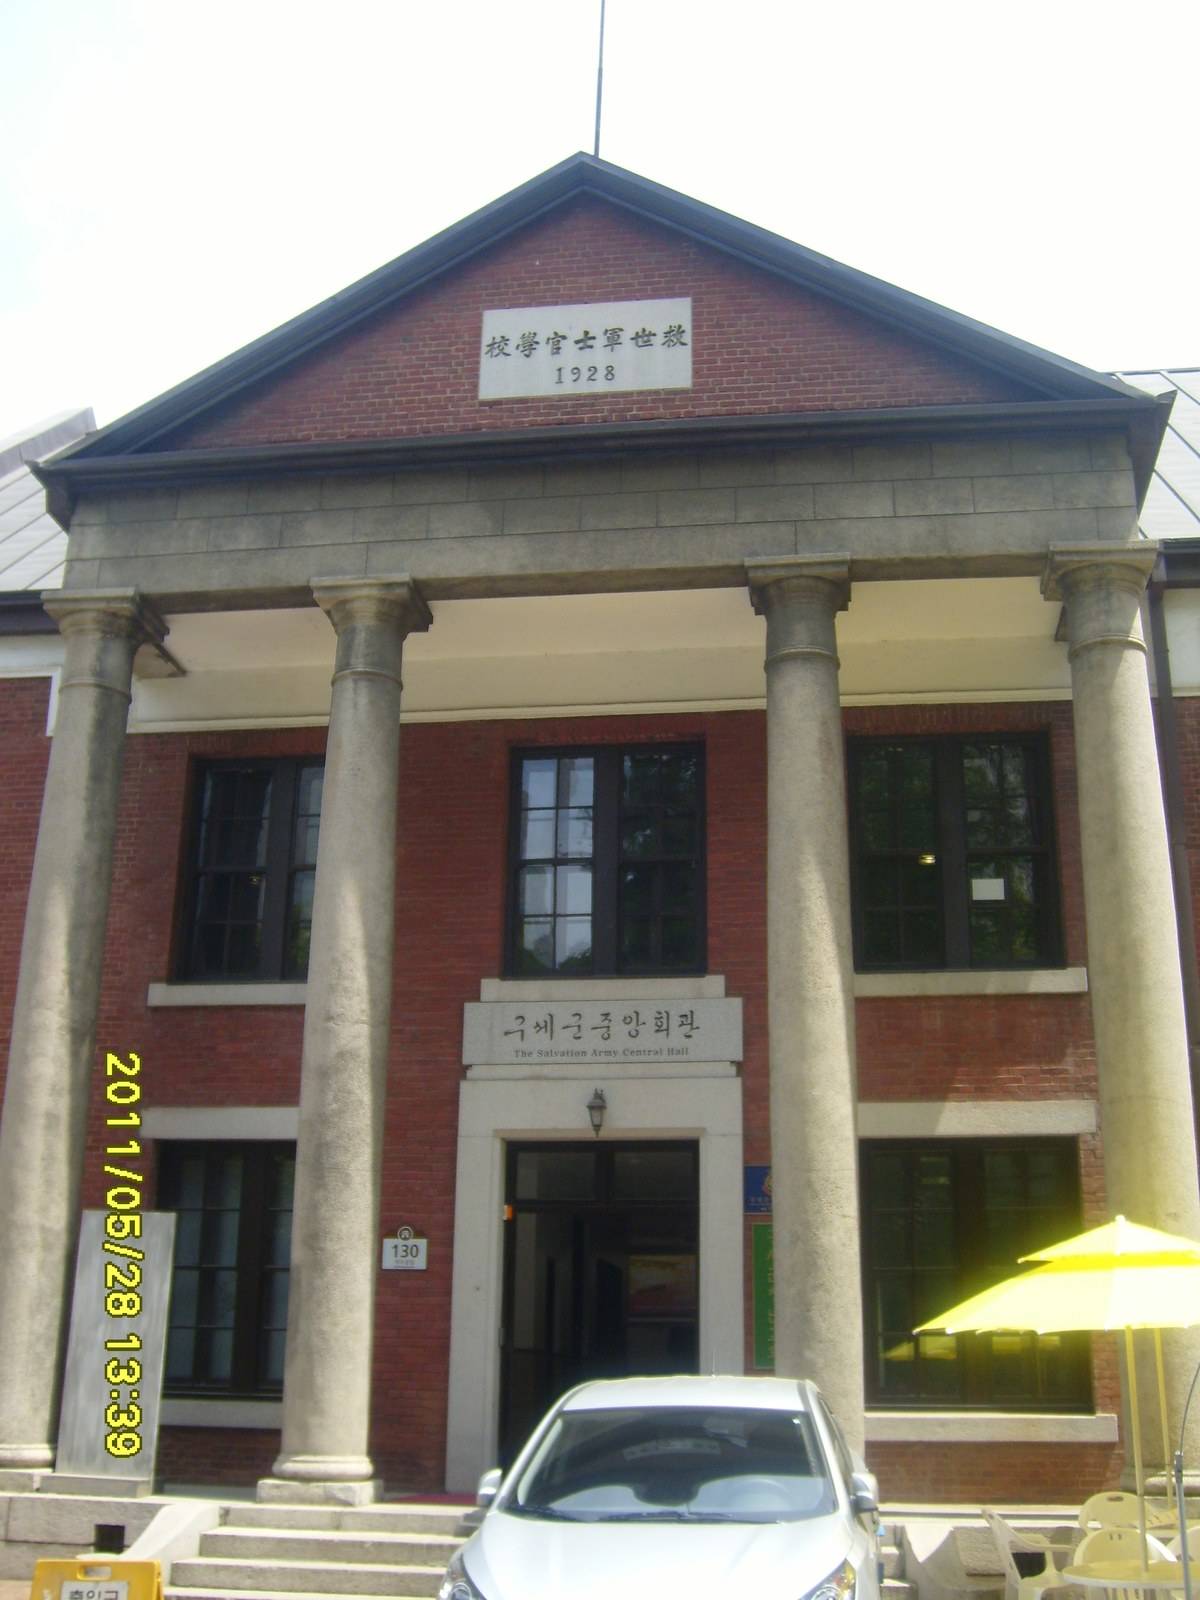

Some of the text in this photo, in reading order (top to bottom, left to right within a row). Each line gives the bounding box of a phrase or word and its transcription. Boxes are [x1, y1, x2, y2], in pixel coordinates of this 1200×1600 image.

[555, 365, 616, 385] 1928
[504, 1010, 700, 1042] 구세군중앙회관
[514, 1047, 689, 1058] The Salvation Army Central Hall
[391, 1244, 419, 1258] 130
